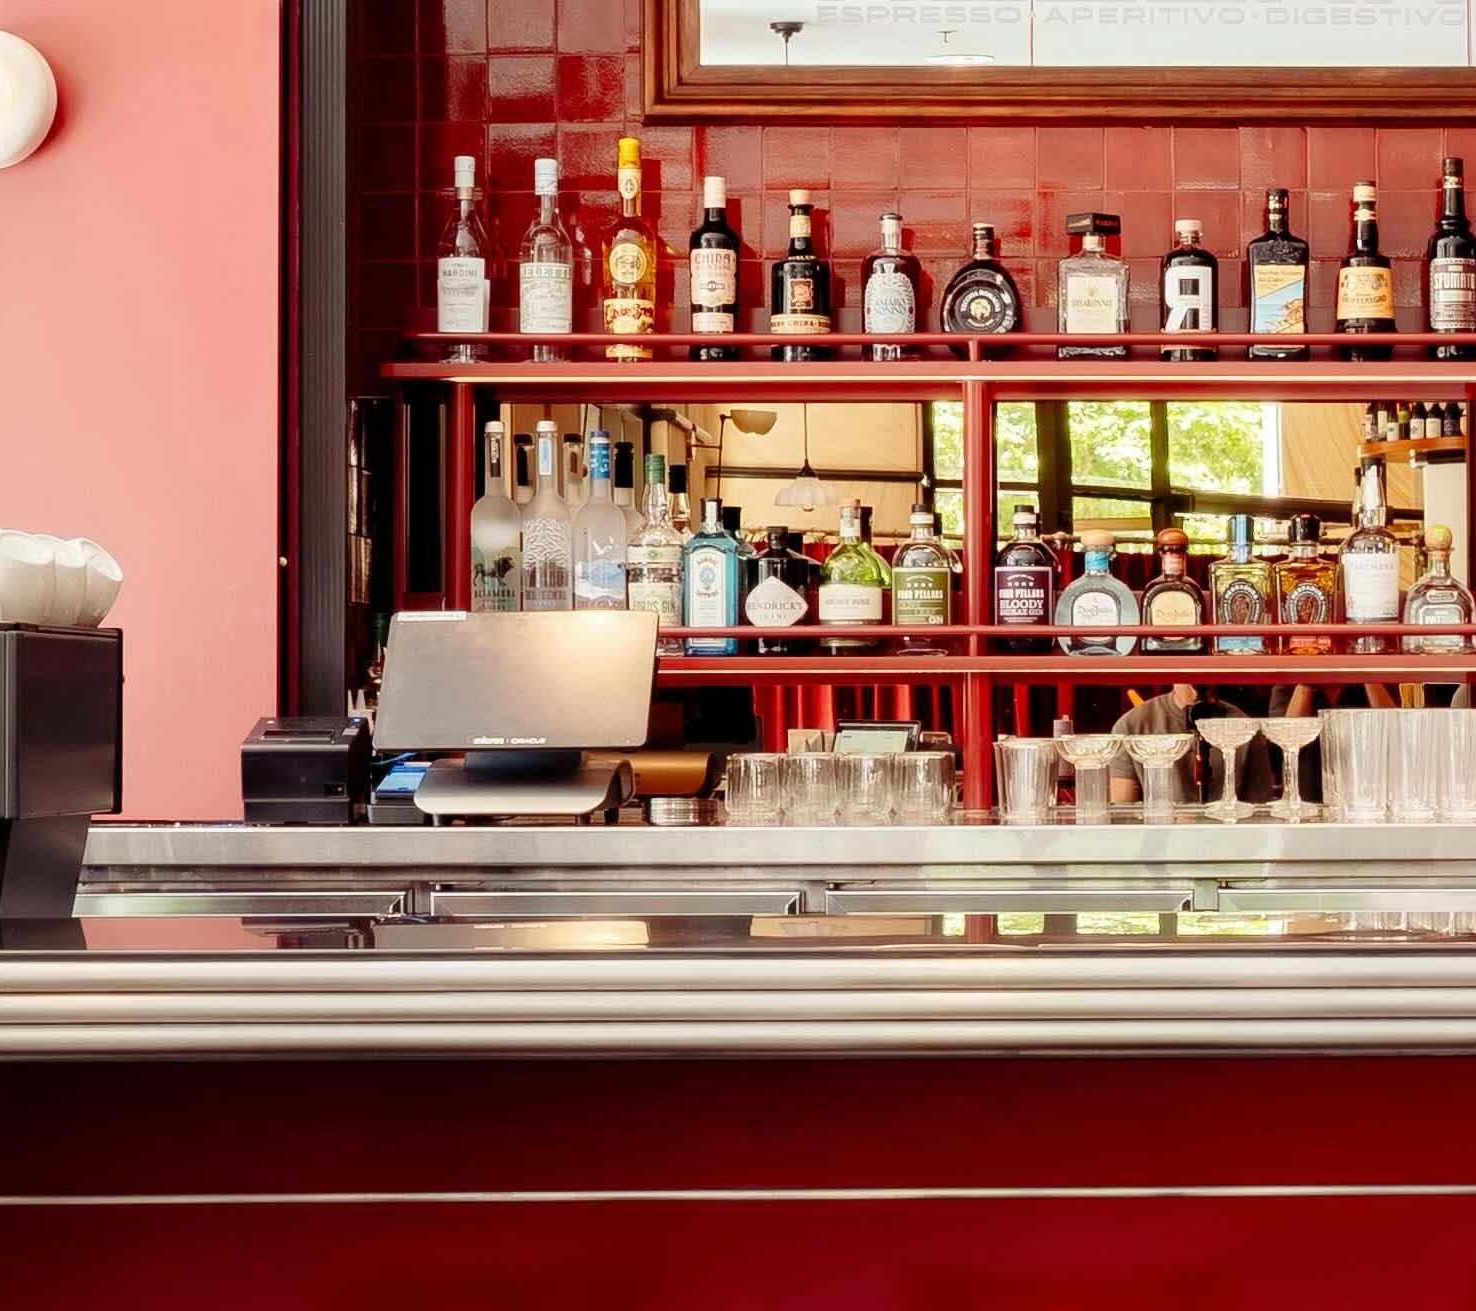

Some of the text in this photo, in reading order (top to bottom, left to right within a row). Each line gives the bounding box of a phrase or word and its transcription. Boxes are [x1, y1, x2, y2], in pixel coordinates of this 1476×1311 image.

[815, 5, 1466, 28] ESPRESSO APERITIVO DIGESTIVO
[999, 599, 1045, 610] BLOODY
